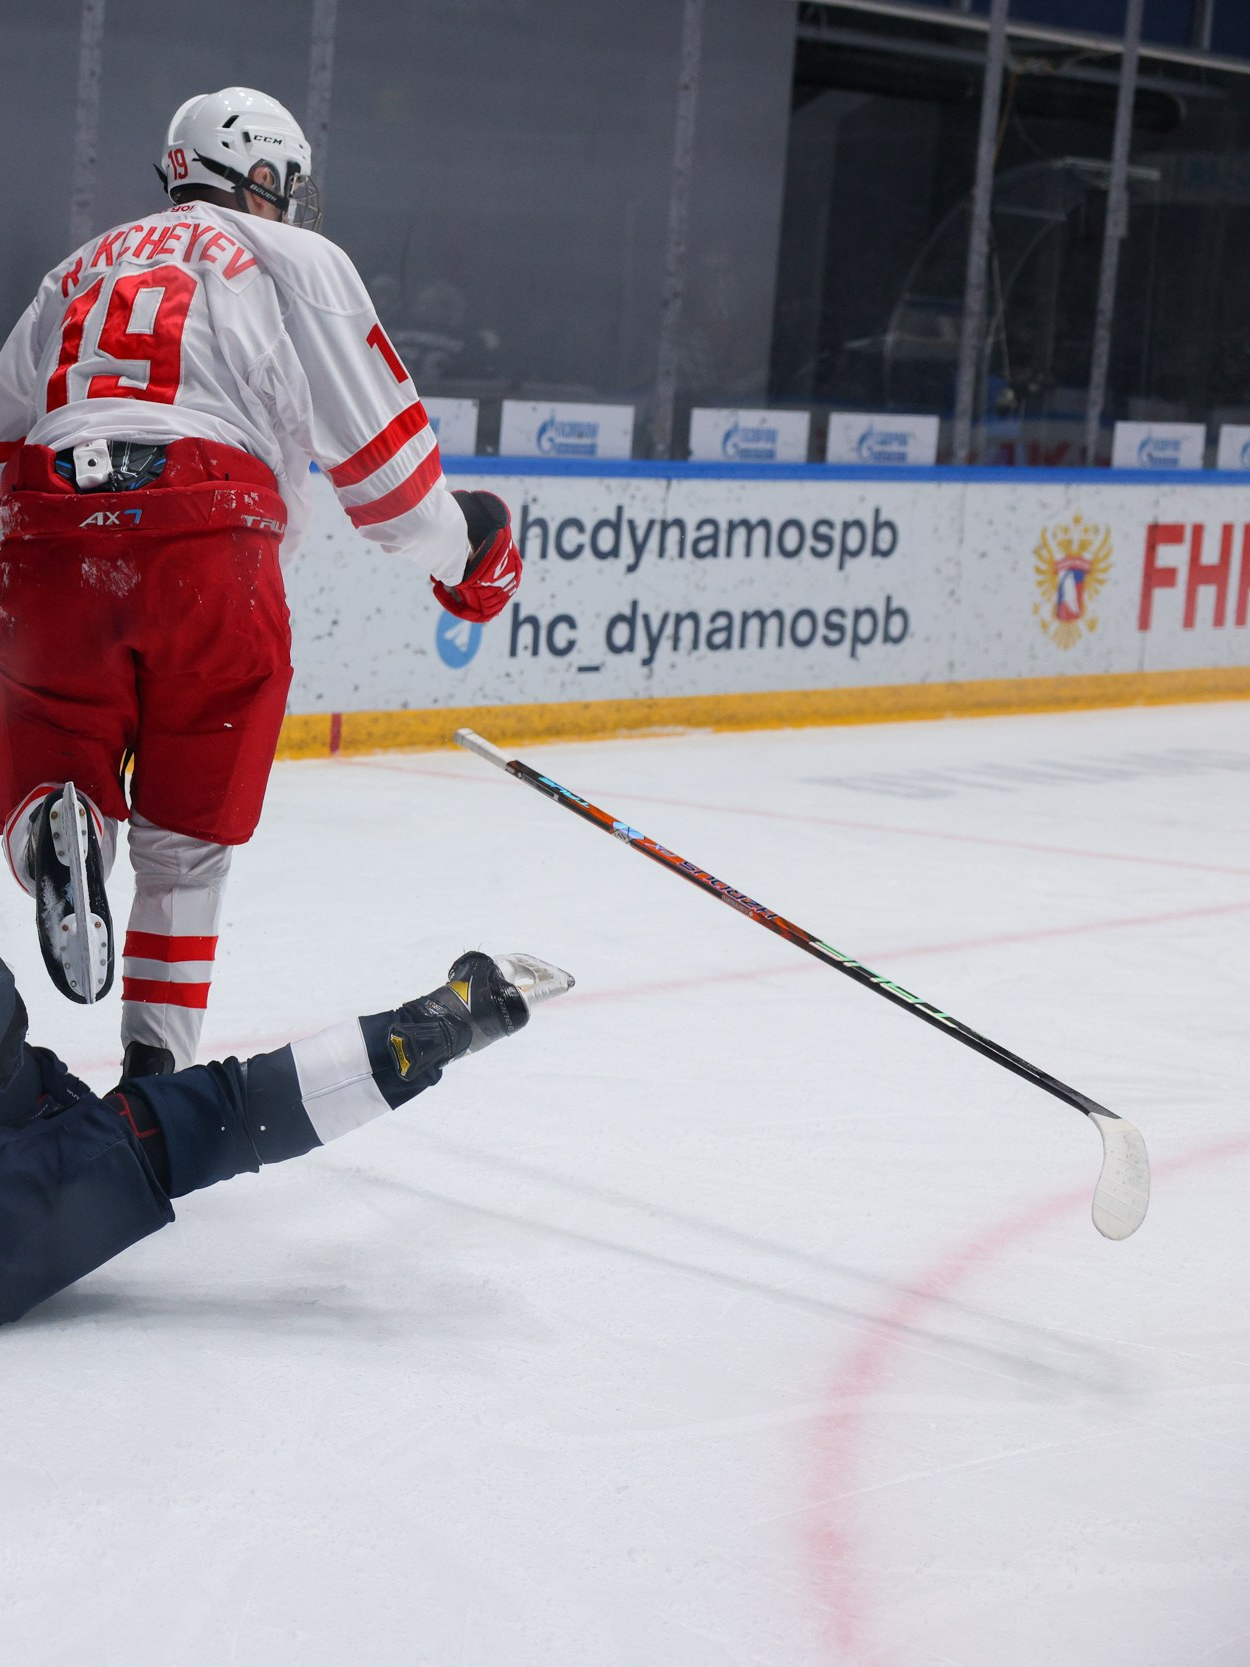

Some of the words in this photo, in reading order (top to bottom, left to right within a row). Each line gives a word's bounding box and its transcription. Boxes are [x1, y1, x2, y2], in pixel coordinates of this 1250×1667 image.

[168, 148, 189, 181] 19
[253, 134, 283, 146] CCM
[61, 221, 258, 299] RKCHEYEV
[46, 264, 198, 414] 19
[78, 508, 143, 528] AX7
[241, 514, 288, 534] TRU
[519, 494, 900, 573] hcdynamospb
[1137, 522, 1250, 633] FH
[508, 594, 911, 674] hc_dynamospb
